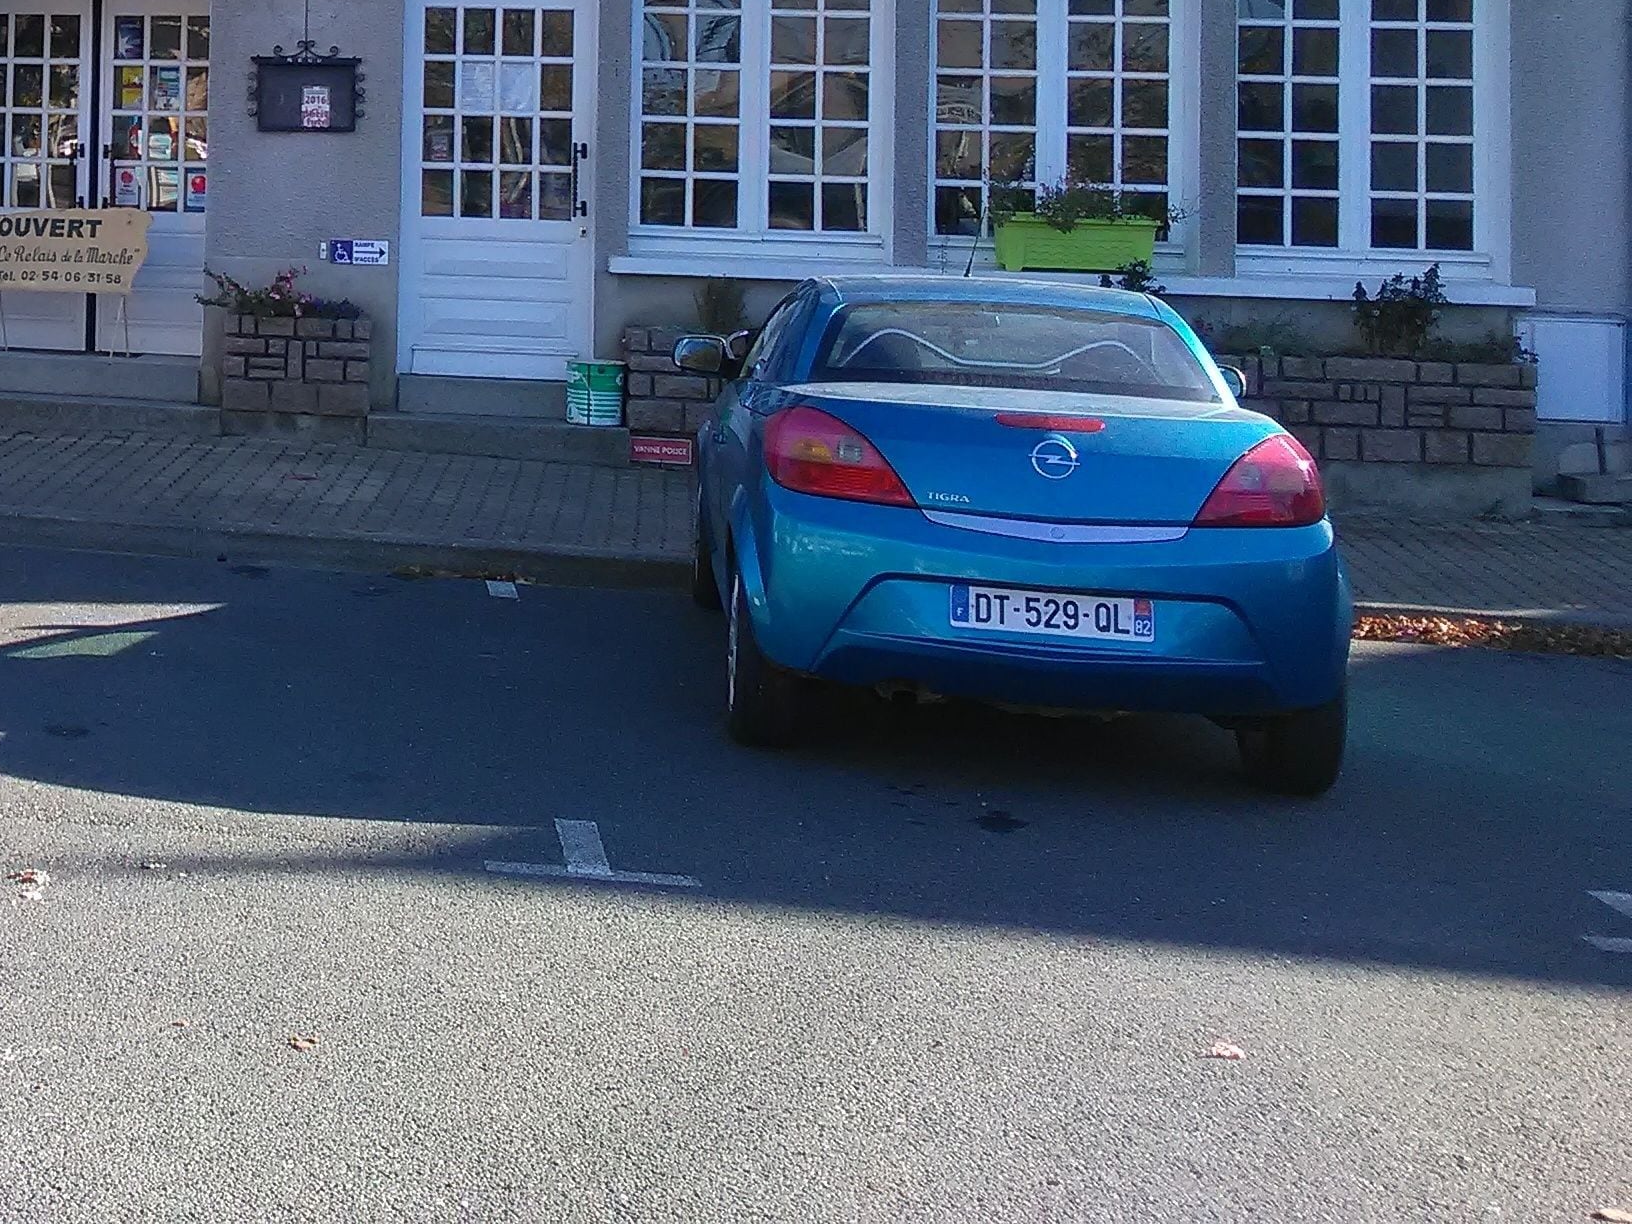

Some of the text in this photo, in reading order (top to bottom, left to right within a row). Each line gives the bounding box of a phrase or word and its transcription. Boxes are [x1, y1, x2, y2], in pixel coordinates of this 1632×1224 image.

[305, 96, 327, 105] 2016
[14, 246, 57, 263] Relais
[61, 250, 72, 262] de
[74, 250, 84, 263] la
[928, 492, 970, 503] TIGRA
[975, 593, 1130, 635] DT-529-QL
[1135, 620, 1151, 636] 82
